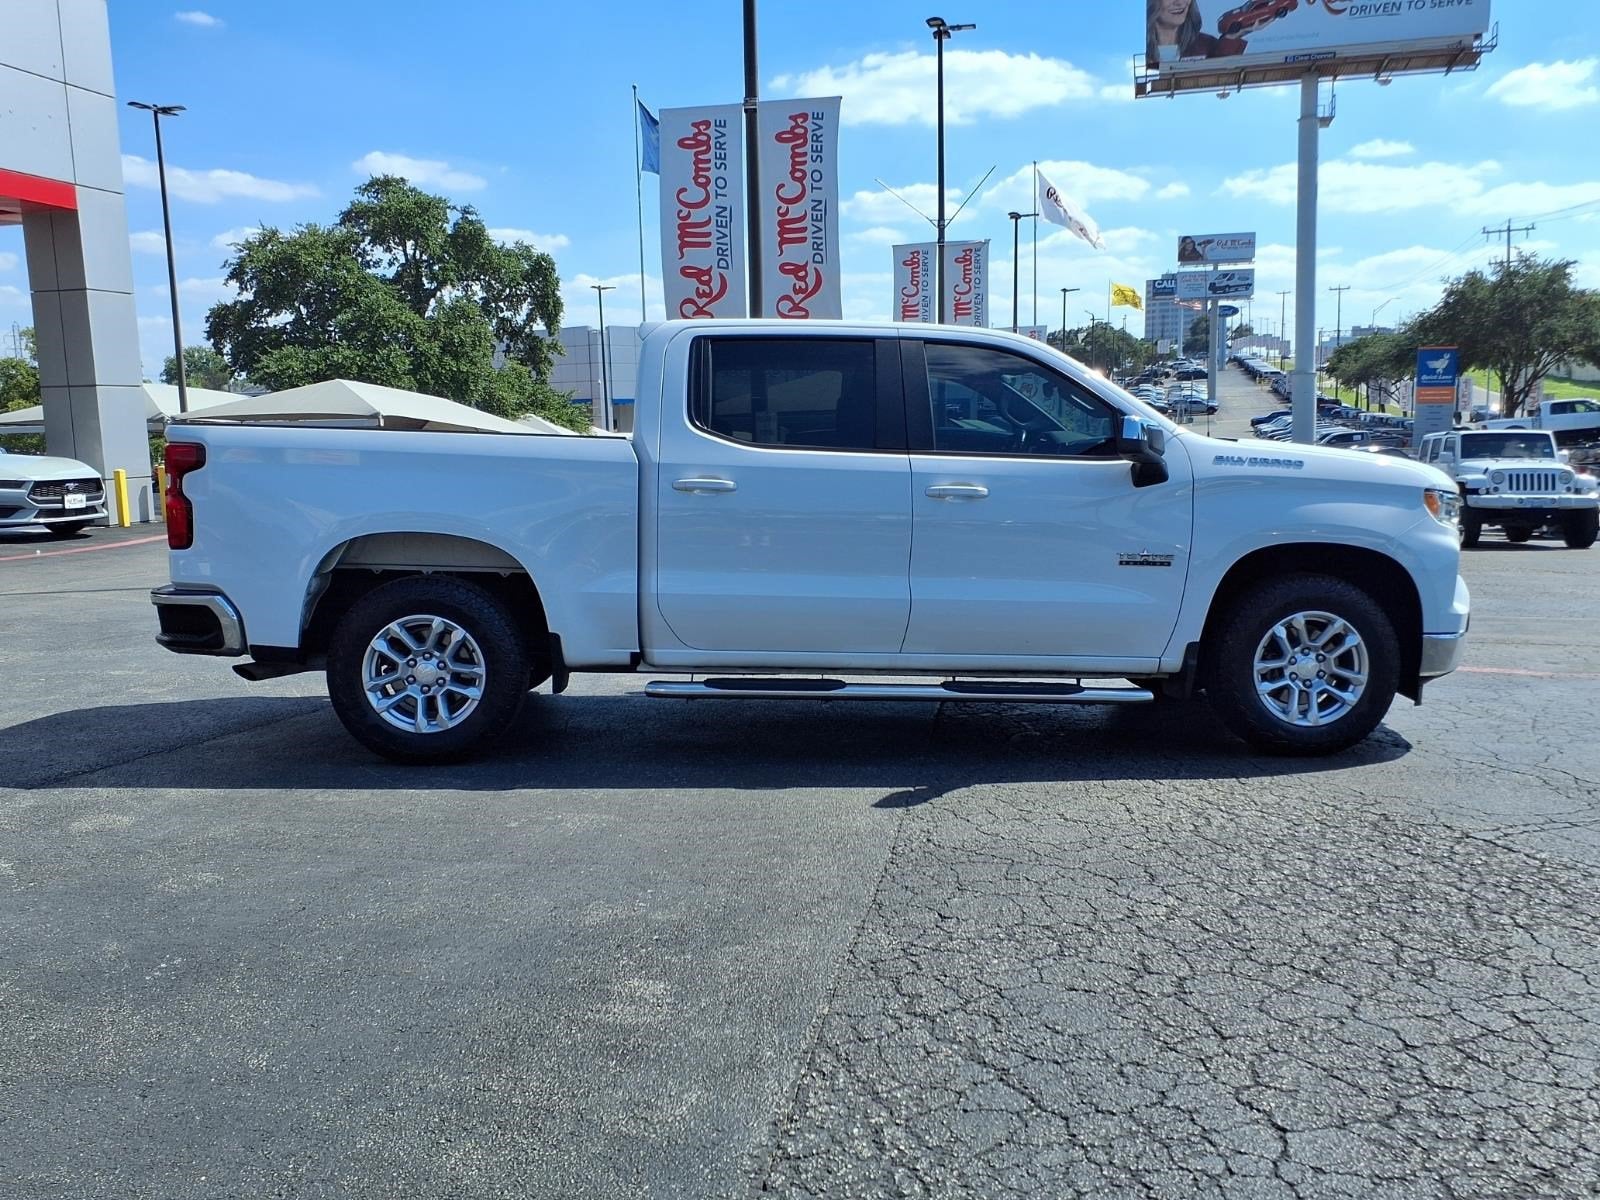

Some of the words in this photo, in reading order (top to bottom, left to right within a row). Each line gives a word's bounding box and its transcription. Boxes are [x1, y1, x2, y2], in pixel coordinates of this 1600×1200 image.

[1349, 2, 1401, 16] DRIVEN
[1408, 0, 1425, 10] TO
[714, 119, 727, 171] SERVE
[811, 111, 824, 163] SERVE
[676, 119, 713, 260] McCombs
[715, 177, 728, 199] TO
[774, 112, 809, 257] McCombs
[811, 169, 823, 193] TO
[715, 205, 730, 270] DRIVEN
[811, 199, 824, 265] DRIVEN
[921, 249, 929, 278] SERVE
[974, 247, 982, 275] SERVE
[679, 265, 728, 319] Red
[776, 260, 823, 319] Red
[921, 280, 929, 291] TO
[974, 278, 981, 290] TO
[921, 295, 929, 323] RIVEN
[974, 293, 982, 327] DRIVEN
[1212, 455, 1305, 470] SILVERADO
